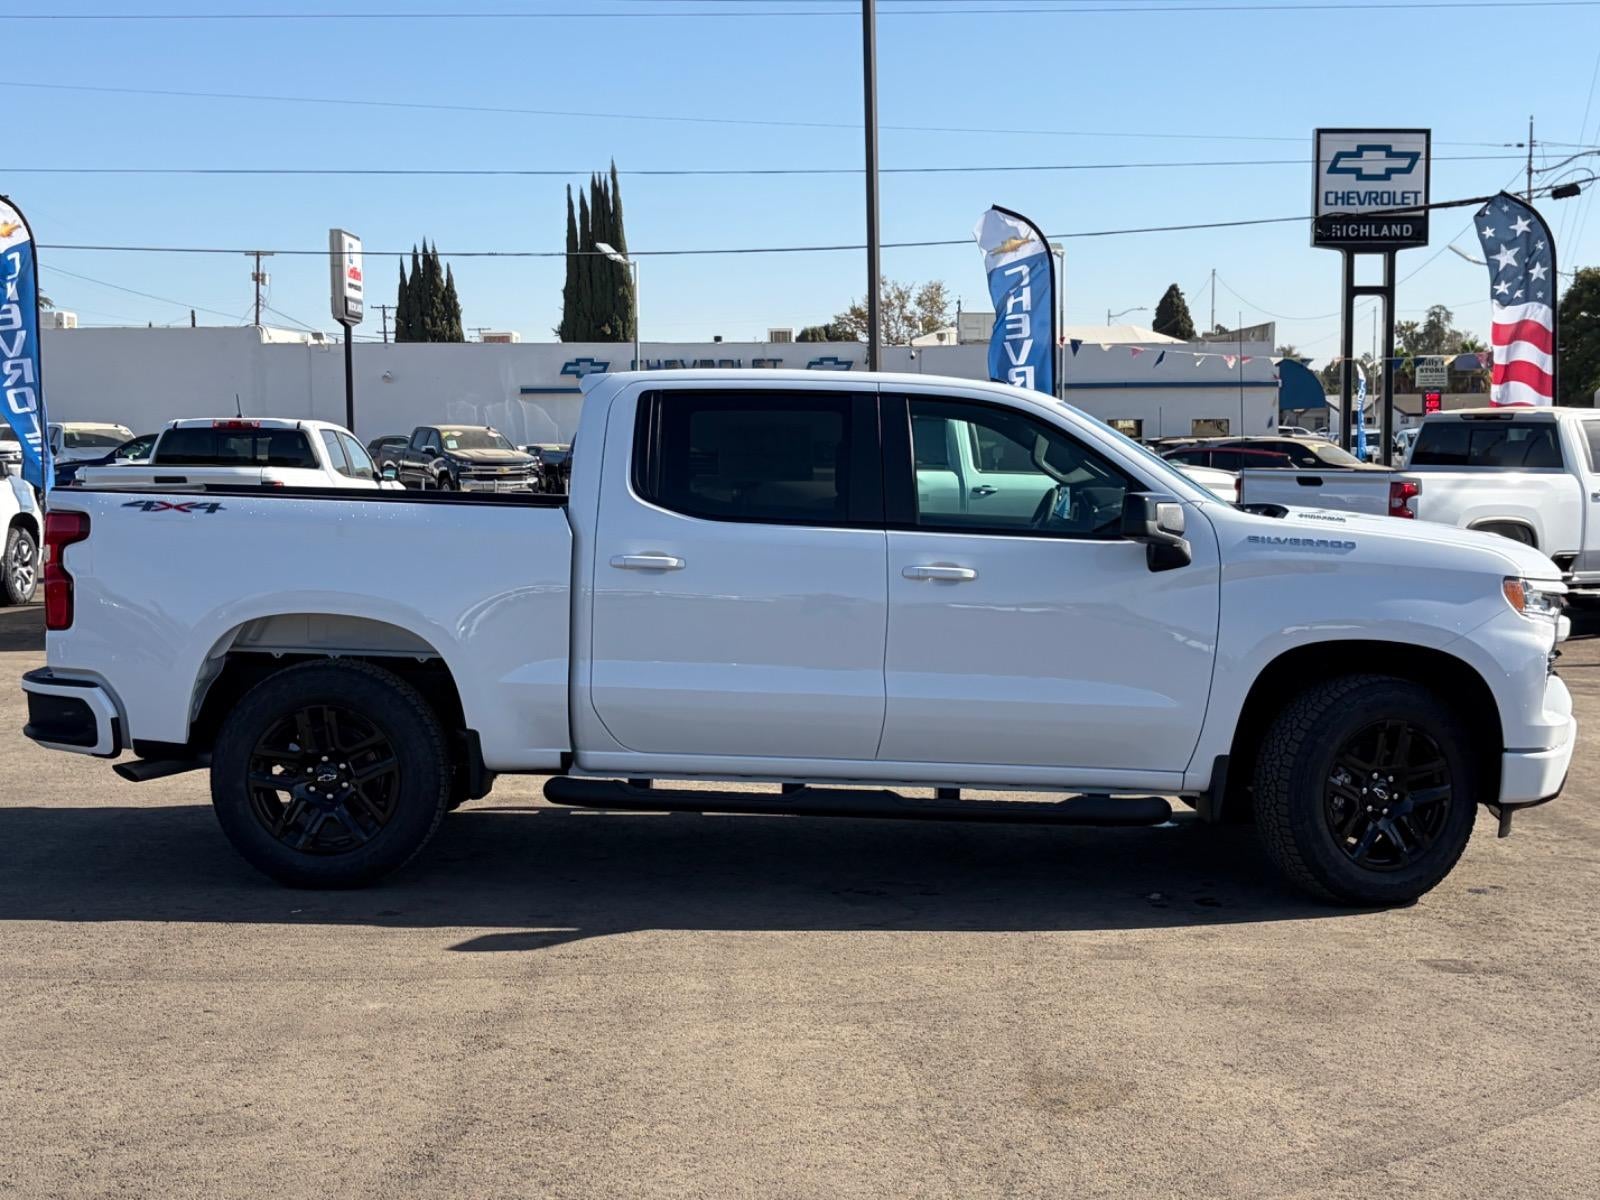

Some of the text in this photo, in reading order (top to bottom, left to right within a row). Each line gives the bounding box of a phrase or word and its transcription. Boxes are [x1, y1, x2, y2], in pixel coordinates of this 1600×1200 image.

[1324, 190, 1422, 206] CHEVROLET
[1331, 224, 1413, 237] RICHLAND
[1247, 535, 1357, 549] SILVERADO
